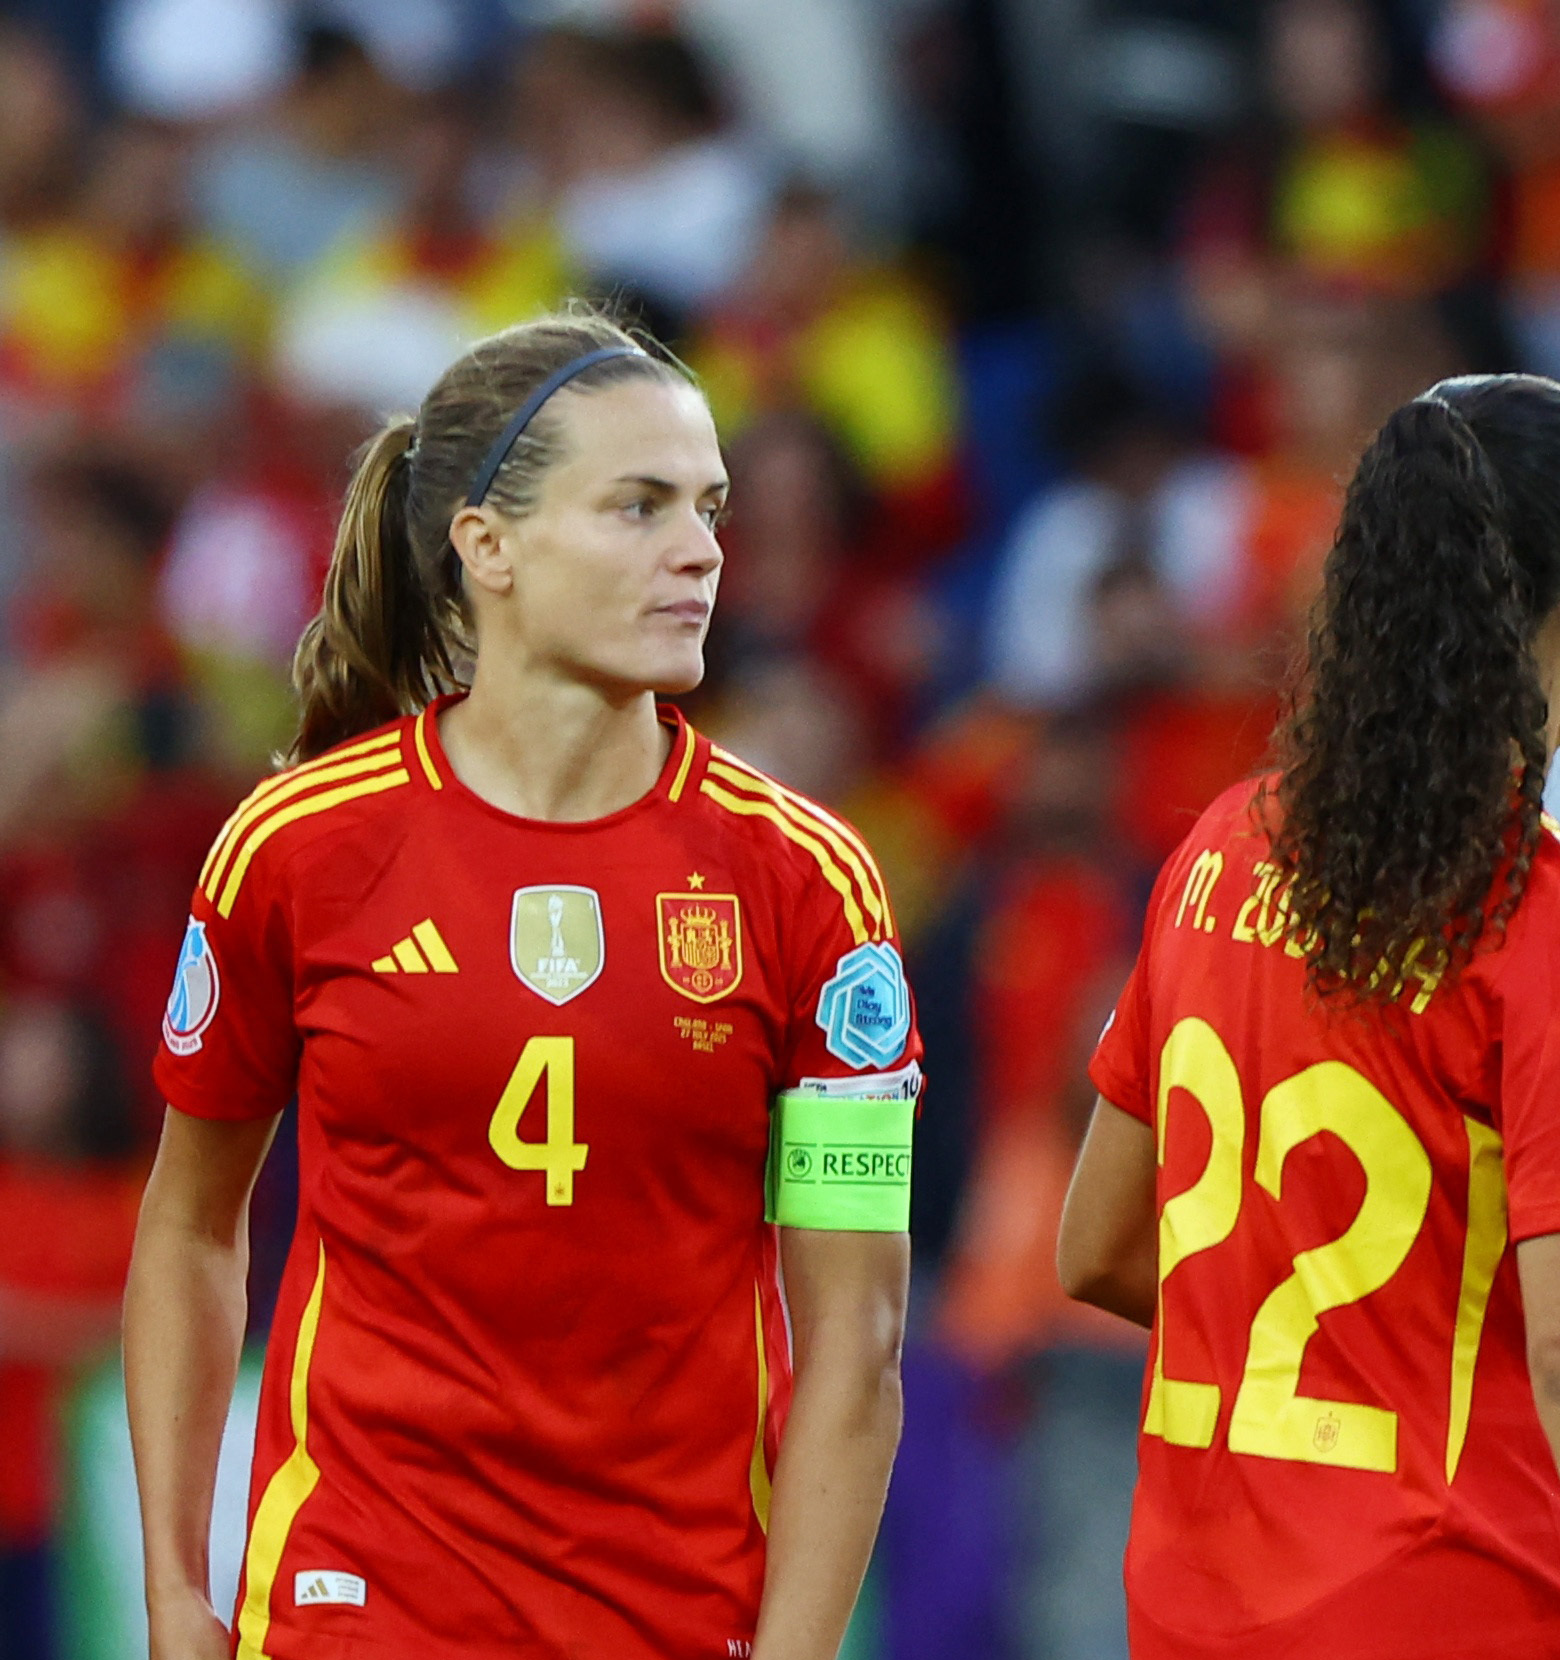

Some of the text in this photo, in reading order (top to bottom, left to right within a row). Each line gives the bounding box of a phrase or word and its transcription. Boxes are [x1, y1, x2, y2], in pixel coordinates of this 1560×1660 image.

[1174, 848, 1224, 934] M.
[488, 1035, 589, 1206] 4
[1143, 1016, 1432, 1473] 22
